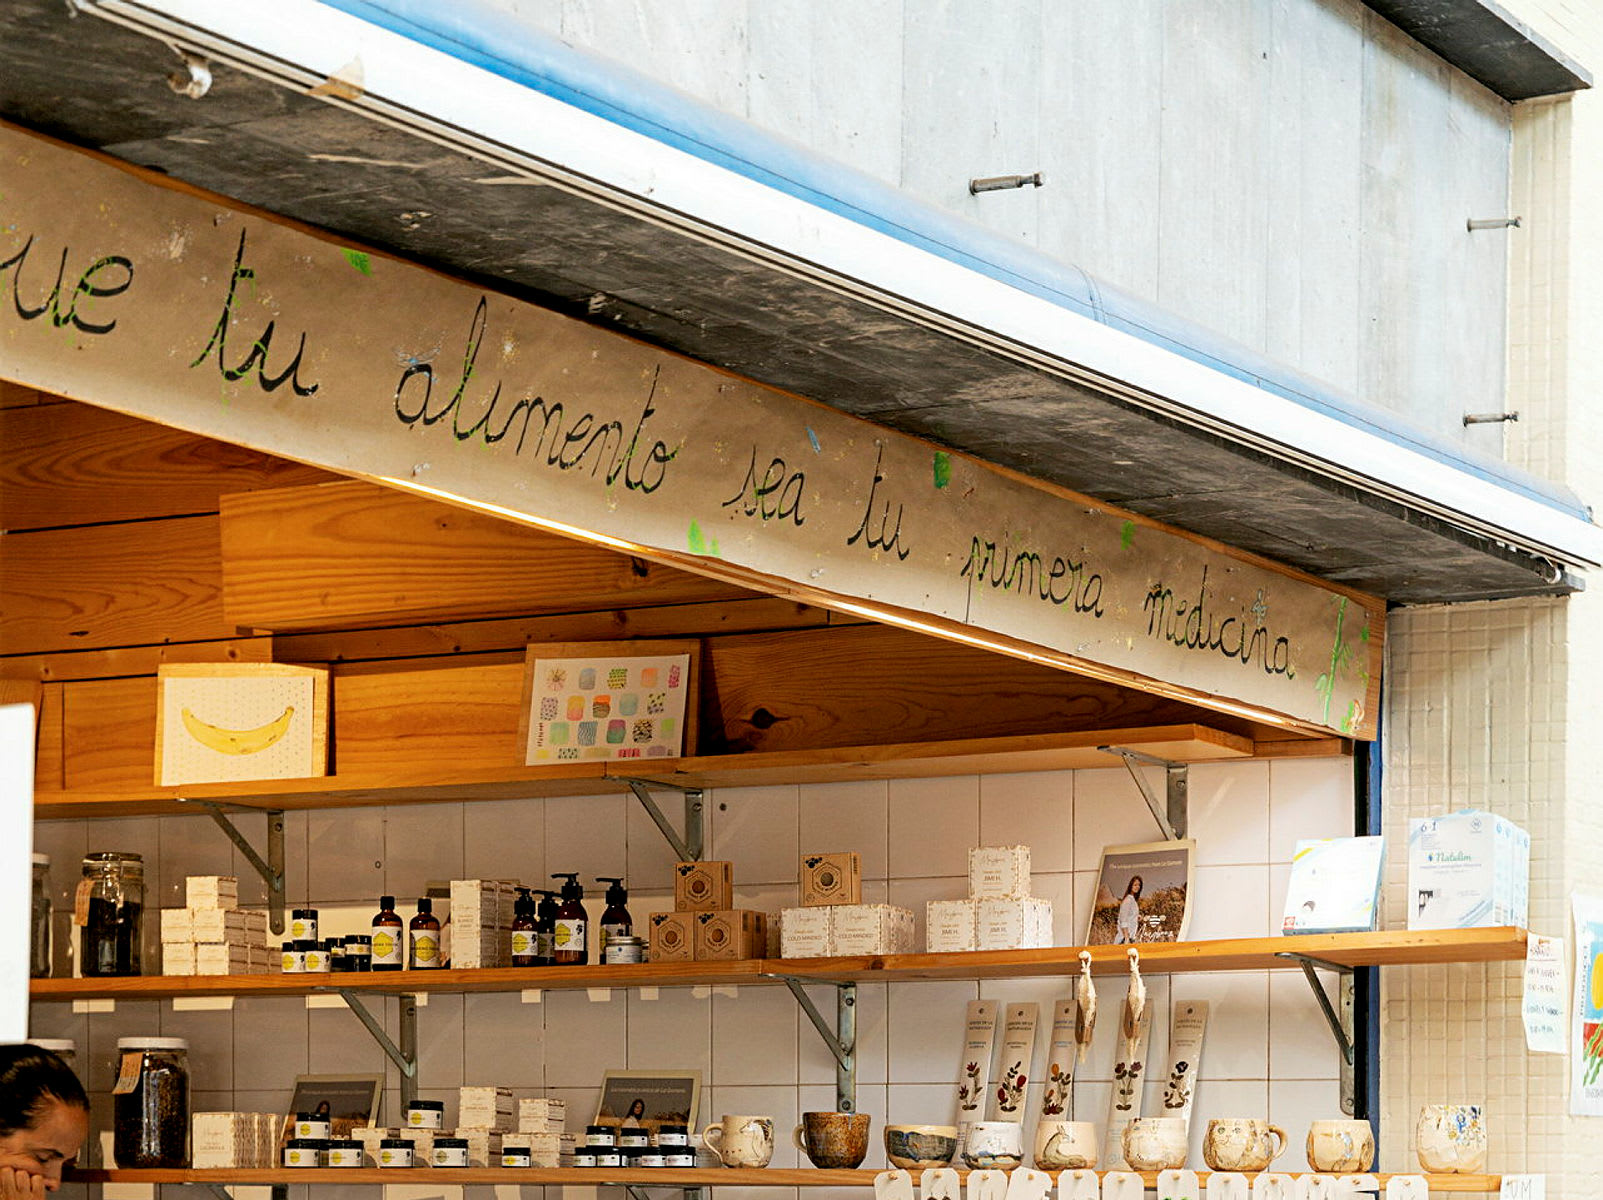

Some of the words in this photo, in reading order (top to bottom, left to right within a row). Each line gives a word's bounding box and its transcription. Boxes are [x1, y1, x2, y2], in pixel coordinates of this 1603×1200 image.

[0, 233, 134, 335] ue
[190, 226, 319, 397] tu
[394, 294, 679, 495] alimento
[722, 444, 805, 526] sea
[847, 444, 910, 561] tu
[960, 529, 1104, 625] primera
[1144, 564, 1295, 681] medicina
